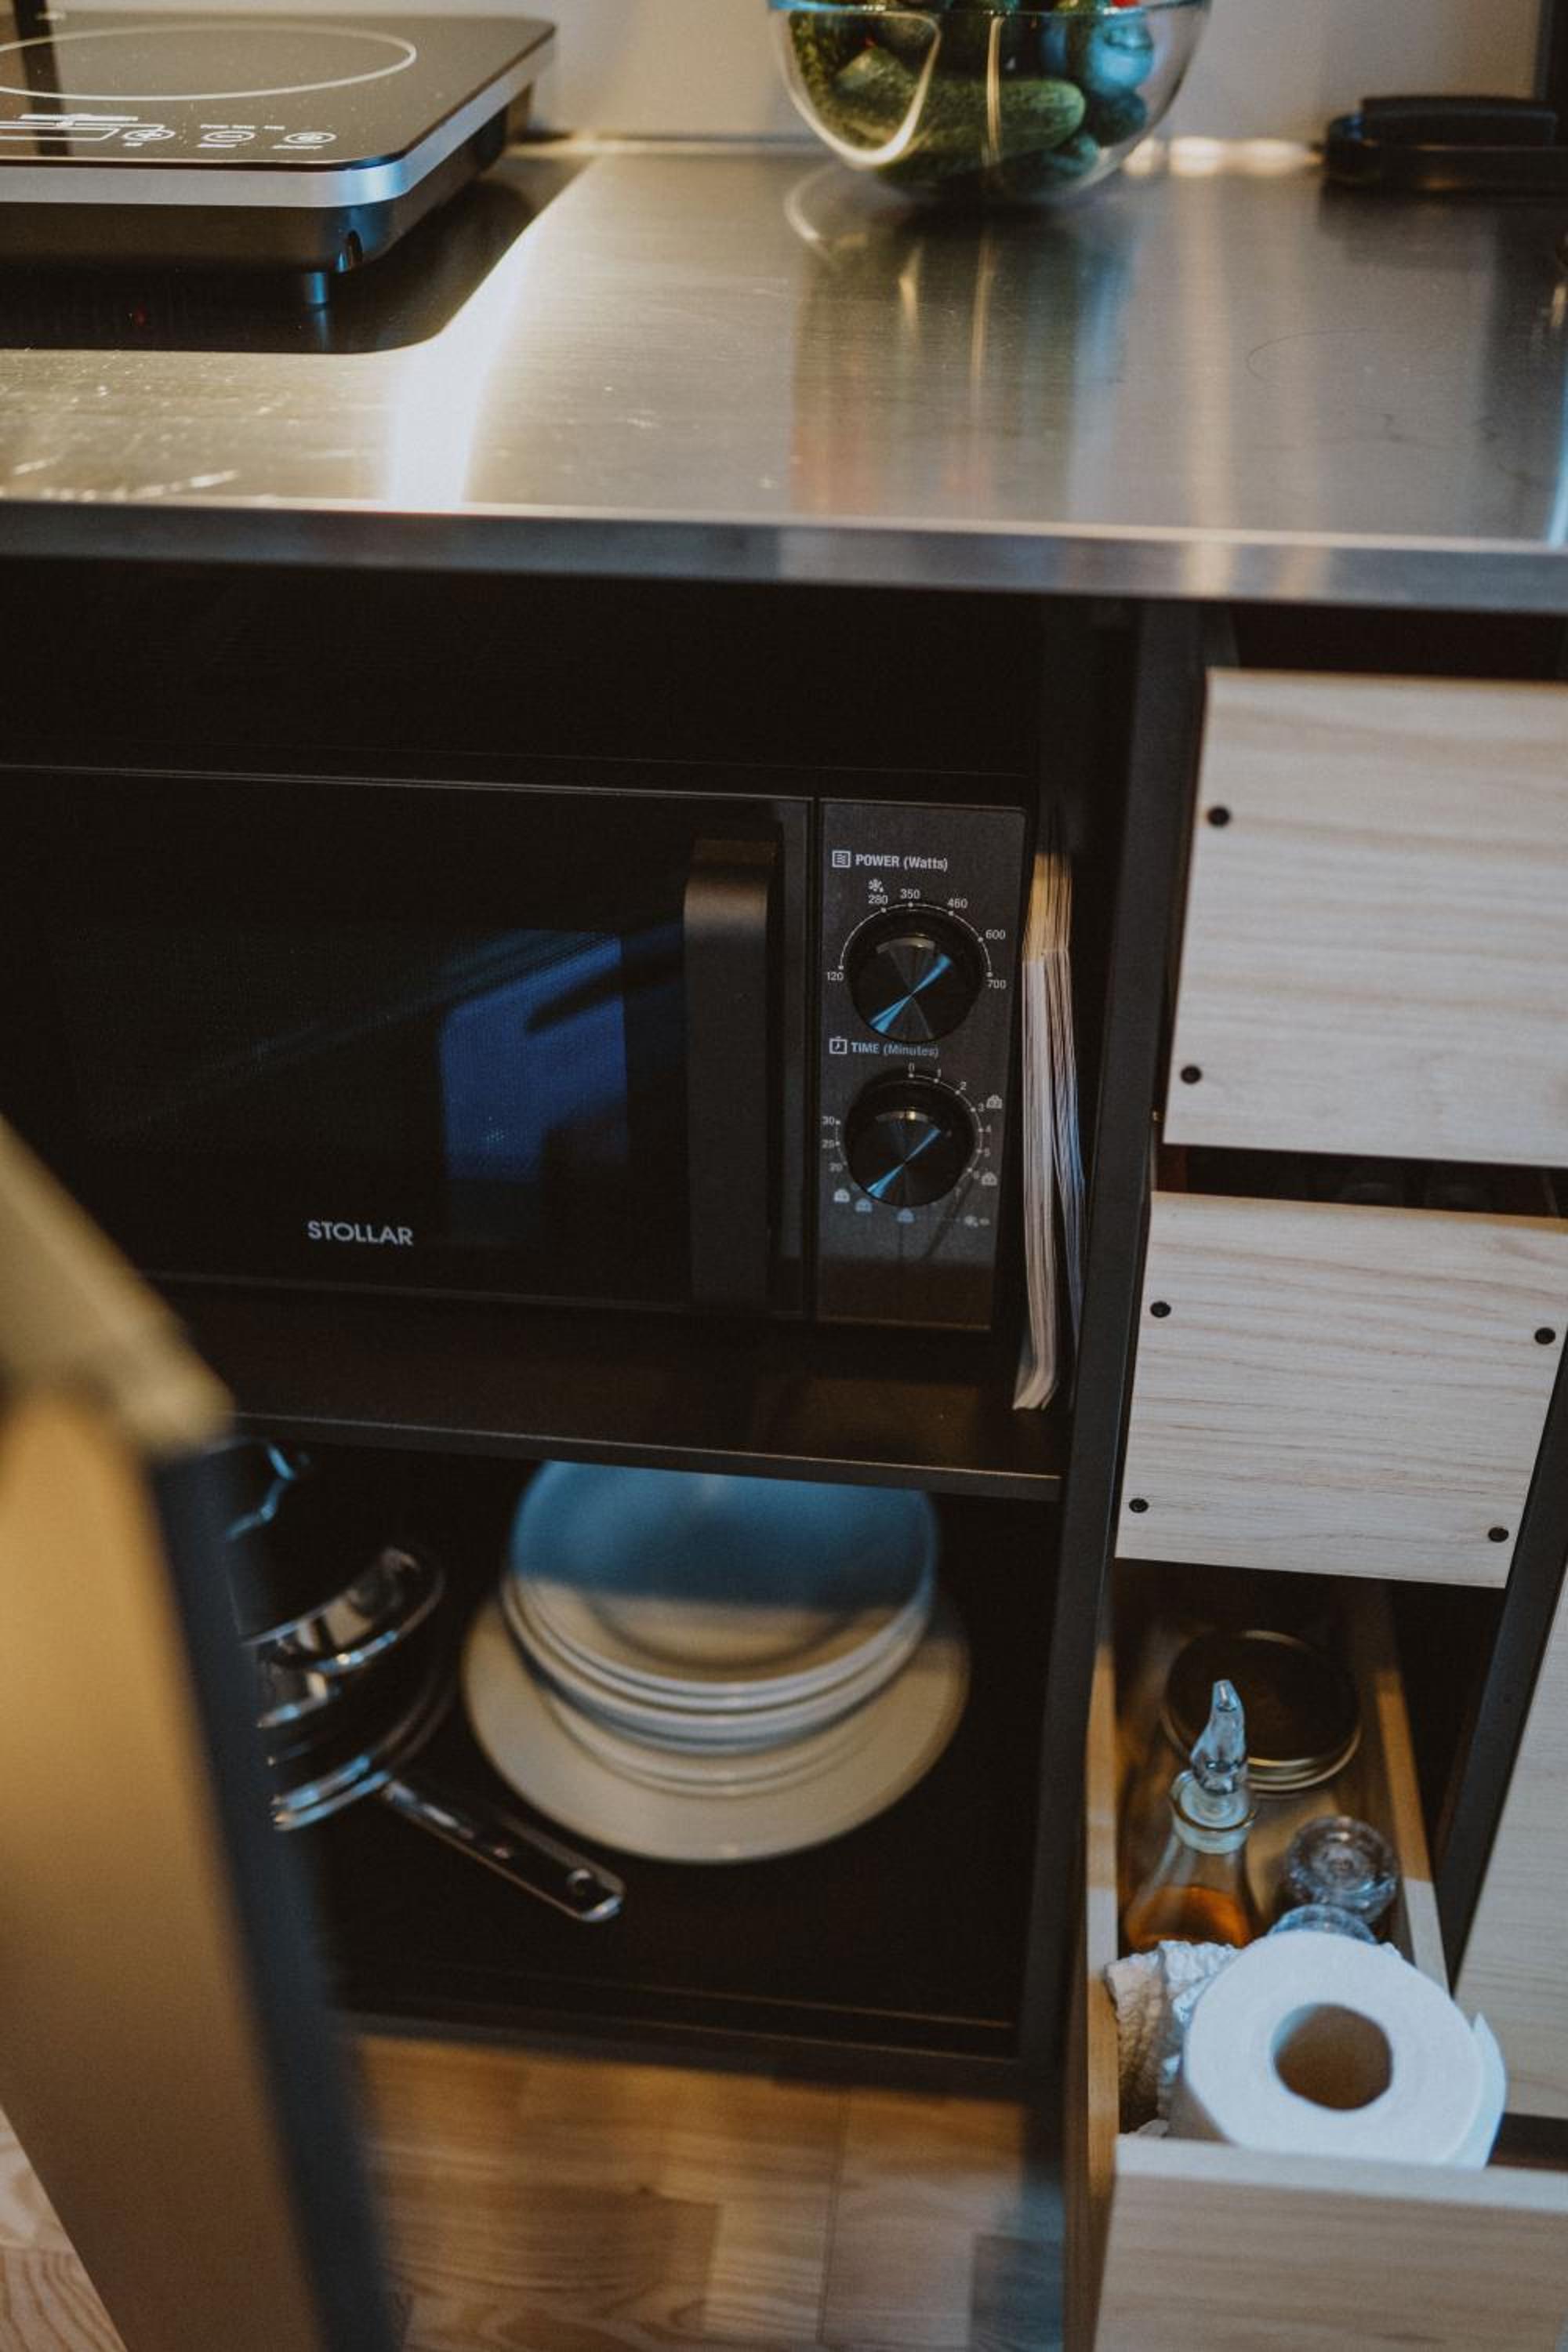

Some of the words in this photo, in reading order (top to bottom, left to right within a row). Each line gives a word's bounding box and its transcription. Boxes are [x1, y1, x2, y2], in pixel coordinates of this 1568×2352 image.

[855, 854, 900, 867] POWER
[903, 855, 949, 872] (Watts)
[900, 888, 920, 899] 350
[868, 895, 888, 905] 280
[985, 929, 1006, 939] 600
[826, 971, 844, 982] 120
[987, 979, 1007, 989] 700
[851, 1042, 880, 1054] TIME
[883, 1044, 939, 1058] (Minutes)
[960, 1081, 967, 1091] 2
[978, 1102, 985, 1112] 3
[822, 1116, 835, 1125] 30
[985, 1124, 992, 1134] 4
[984, 1147, 990, 1157] 5
[307, 1219, 414, 1246] STOLLAR
